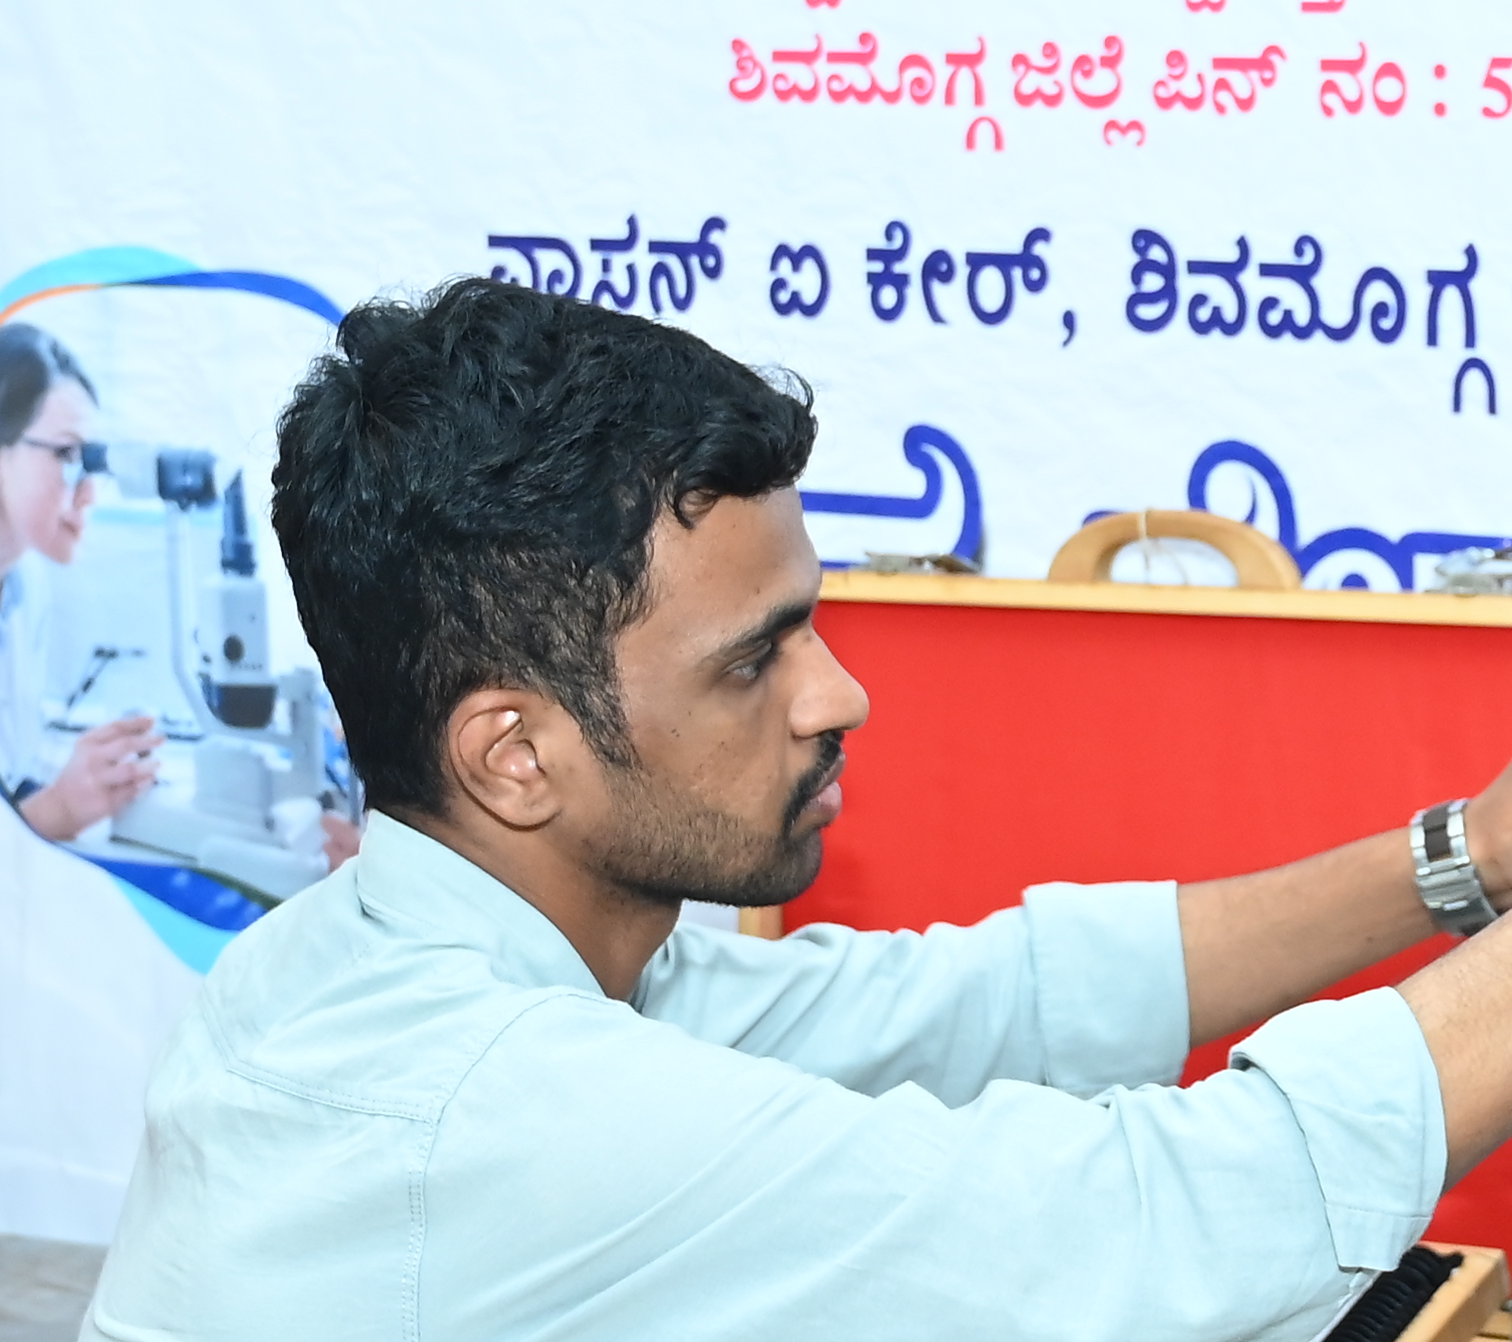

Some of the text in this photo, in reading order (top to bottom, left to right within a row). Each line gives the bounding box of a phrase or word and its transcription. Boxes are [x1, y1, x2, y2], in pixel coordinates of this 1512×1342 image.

[729, 32, 1004, 151] ಶಿವಮೊಗ್ಗ
[1012, 35, 1145, 146] ಜಿಲ್ಲೆ
[1154, 45, 1286, 115] ಪಿನ್
[1320, 43, 1406, 117] ನಂ
[770, 244, 830, 318] ಐ
[867, 220, 1076, 338] ಕೇರ್,
[1126, 230, 1496, 411] ಶಿವಮೊಗ್ಗ
